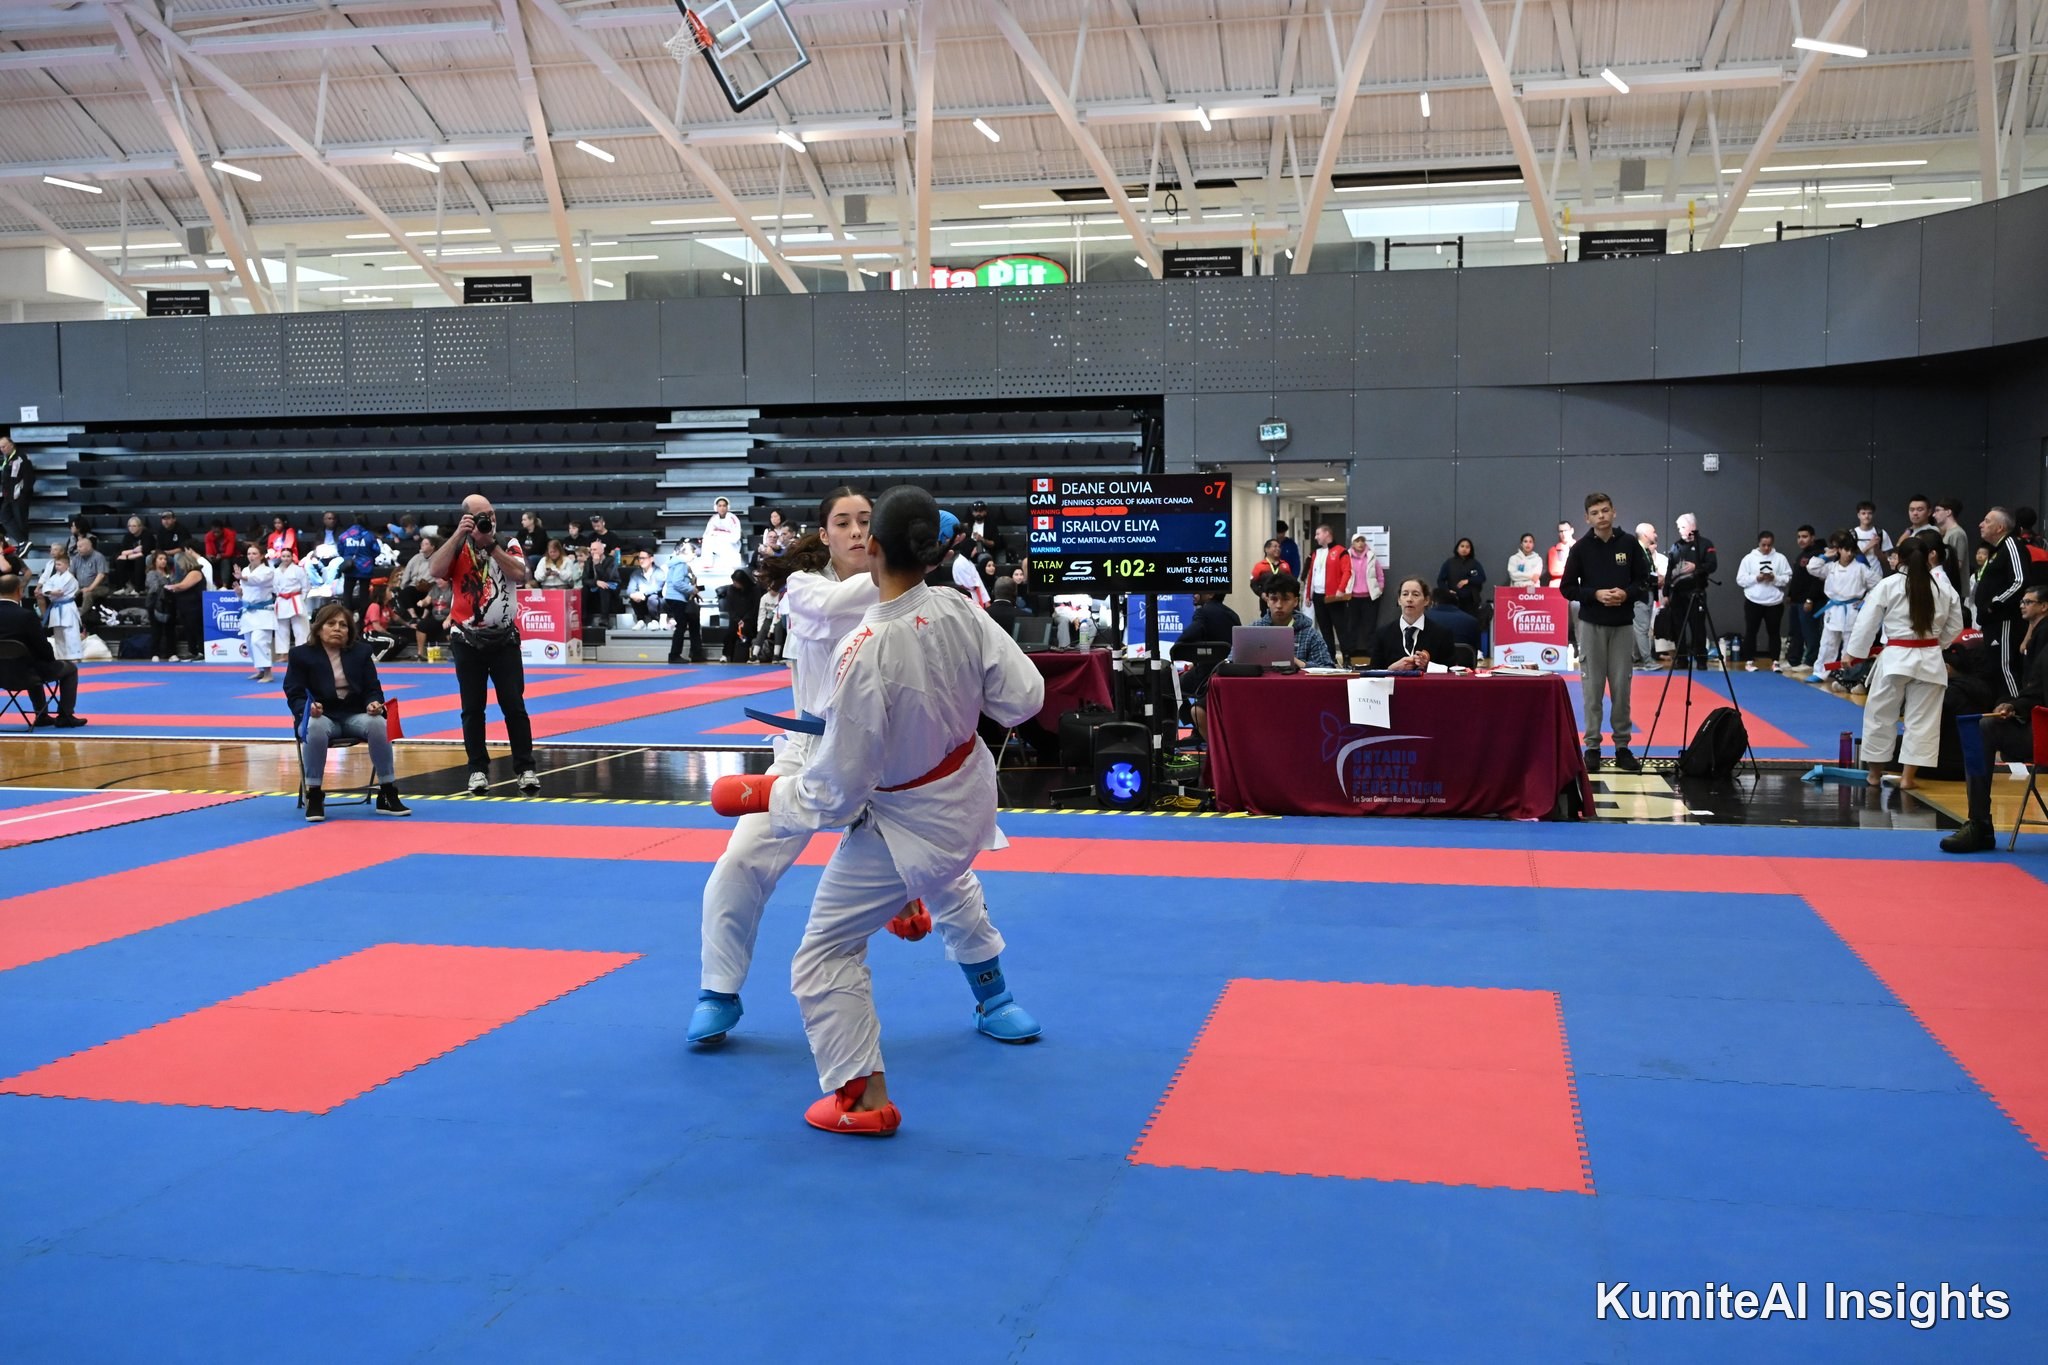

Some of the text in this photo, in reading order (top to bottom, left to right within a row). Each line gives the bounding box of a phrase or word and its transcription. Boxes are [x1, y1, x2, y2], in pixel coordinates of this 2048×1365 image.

[988, 263, 1047, 286] Pit
[1062, 481, 1153, 495] DEANE OLIVIA
[1029, 494, 1056, 505] CAN
[1096, 498, 1124, 506] SCHOOL
[1136, 497, 1162, 505] KARATE
[1163, 497, 1194, 505] CANADA
[1062, 519, 1160, 532] ISRAILOV ELIYA
[1214, 519, 1226, 538] 2
[1030, 531, 1057, 543] CAN
[1166, 566, 1193, 574] KUMITE
[1182, 576, 1194, 584] -68
[1194, 576, 1205, 584] KG
[221, 614, 239, 622] KARA
[1158, 615, 1180, 623] RATE
[1518, 615, 1551, 623] KARATE
[1158, 623, 1183, 631] TARIO
[1518, 623, 1555, 631] ONTARIO
[1352, 750, 1417, 764] ONTARIO
[1352, 765, 1409, 779] KARATE
[1352, 781, 1444, 795] FEDERATION
